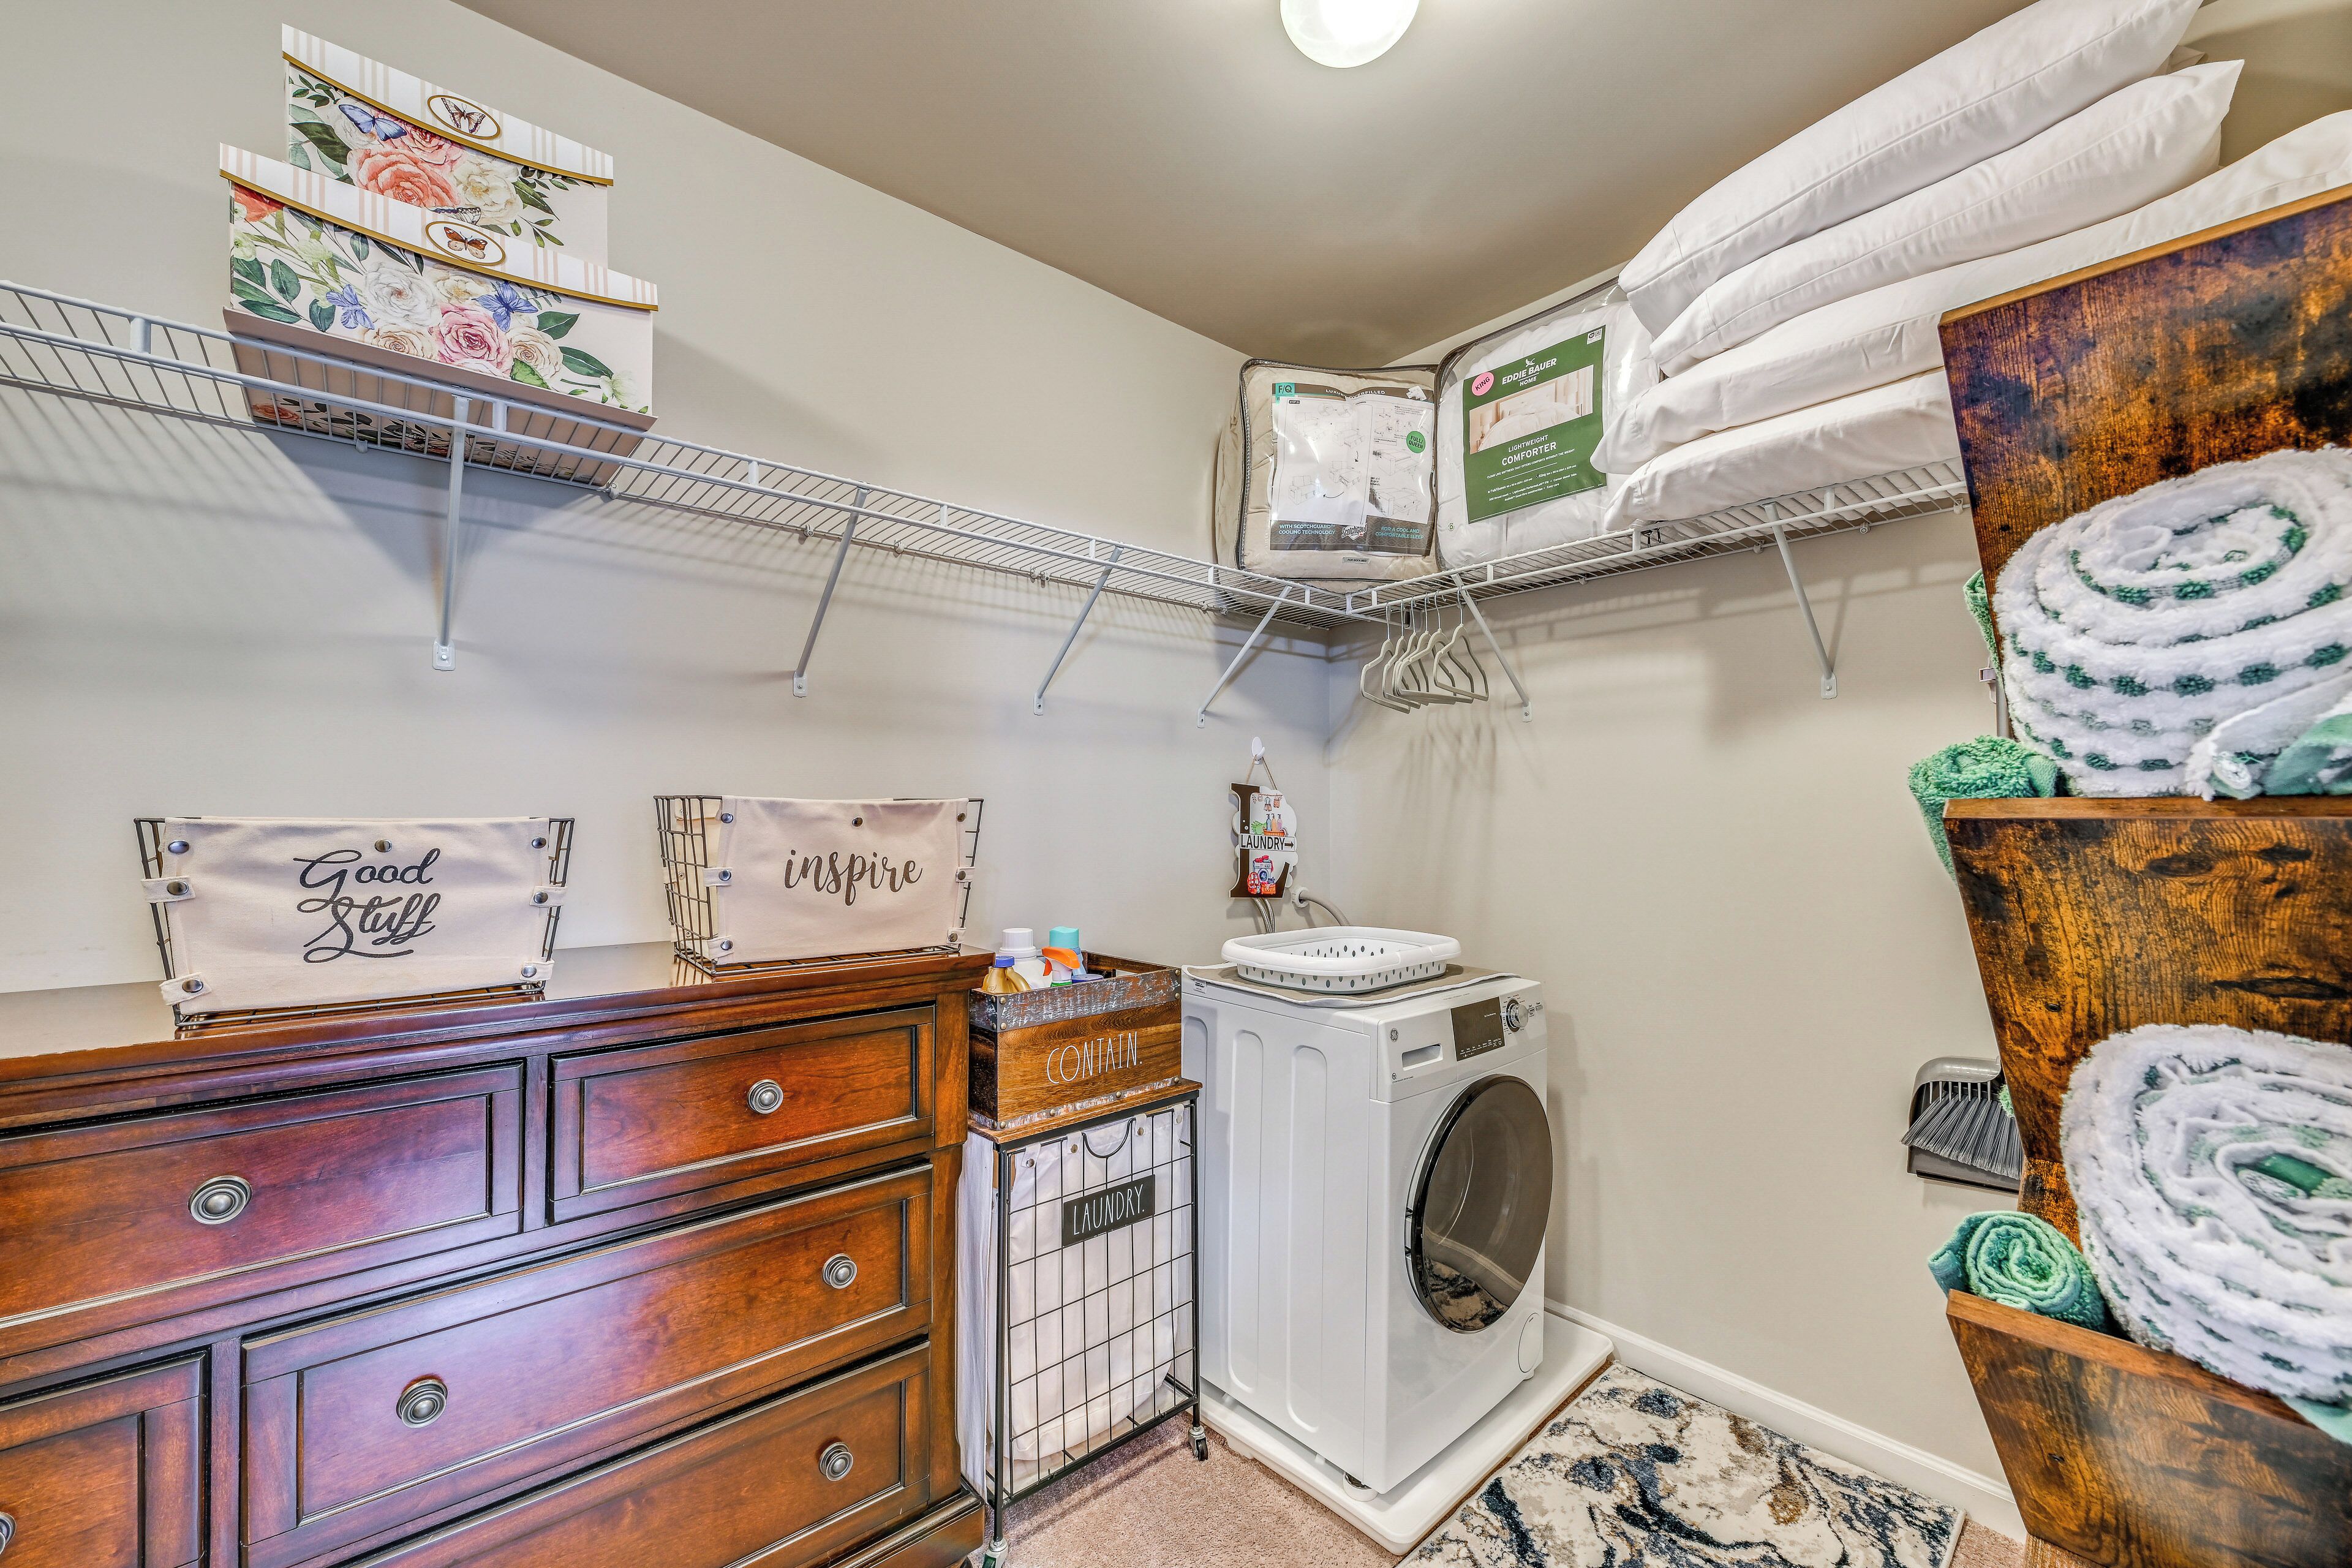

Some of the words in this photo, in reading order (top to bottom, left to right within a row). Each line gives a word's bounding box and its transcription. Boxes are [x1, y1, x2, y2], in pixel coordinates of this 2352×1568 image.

[1502, 369, 1527, 385] EDDIE
[1528, 358, 1557, 374] BAUER
[1278, 385, 1292, 394] F/Q
[1475, 377, 1490, 391] KING
[1520, 376, 1537, 386] HOME
[1325, 389, 1346, 399] LUXURY
[1408, 440, 1423, 449] QUEEN
[1508, 435, 1548, 453] LIGHTWEIGHT
[1502, 442, 1556, 466] COMFORTER
[1241, 834, 1285, 850] LAUNDRY
[293, 848, 440, 913] Good
[784, 850, 923, 907] inspire
[303, 893, 441, 963] Stuff
[1073, 1184, 1145, 1235] LAUNDRY.
